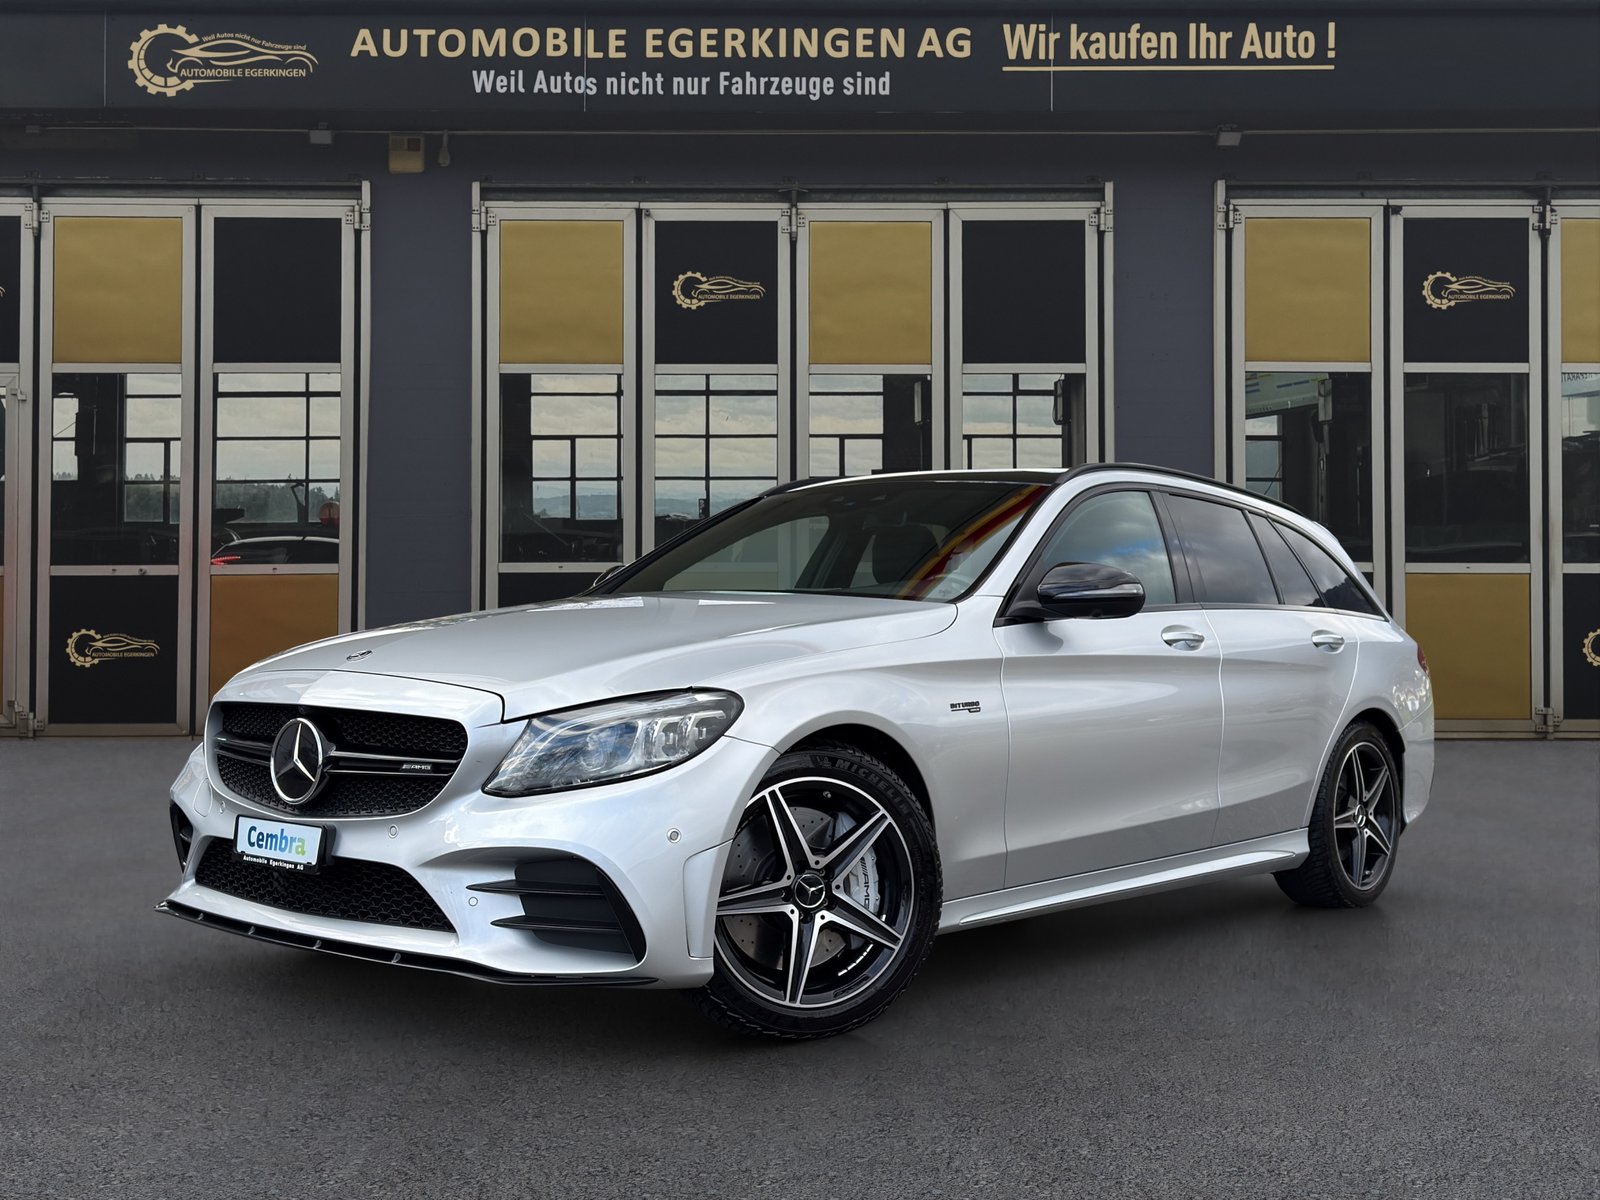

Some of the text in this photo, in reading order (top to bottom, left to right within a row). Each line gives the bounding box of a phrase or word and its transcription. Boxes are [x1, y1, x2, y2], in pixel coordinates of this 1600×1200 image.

[202, 33, 216, 42] Weil
[235, 33, 251, 41] nicht
[261, 40, 292, 50] Fahrzeuge
[350, 27, 972, 59] AUTOMOBILE EGERKINGEN AG
[1002, 23, 1060, 60] Wir
[1070, 23, 1178, 60] kaufen
[1189, 22, 1232, 59] Ihr
[1240, 22, 1316, 59] Auto
[180, 68, 306, 77] AUTOMOBILE EGERKINGEN
[472, 70, 890, 101] Weil Autos nicht nur Fahrzeuge sind
[247, 825, 306, 856] Cembra
[243, 855, 268, 865] Automobile
[269, 859, 295, 869] Egerkingen
